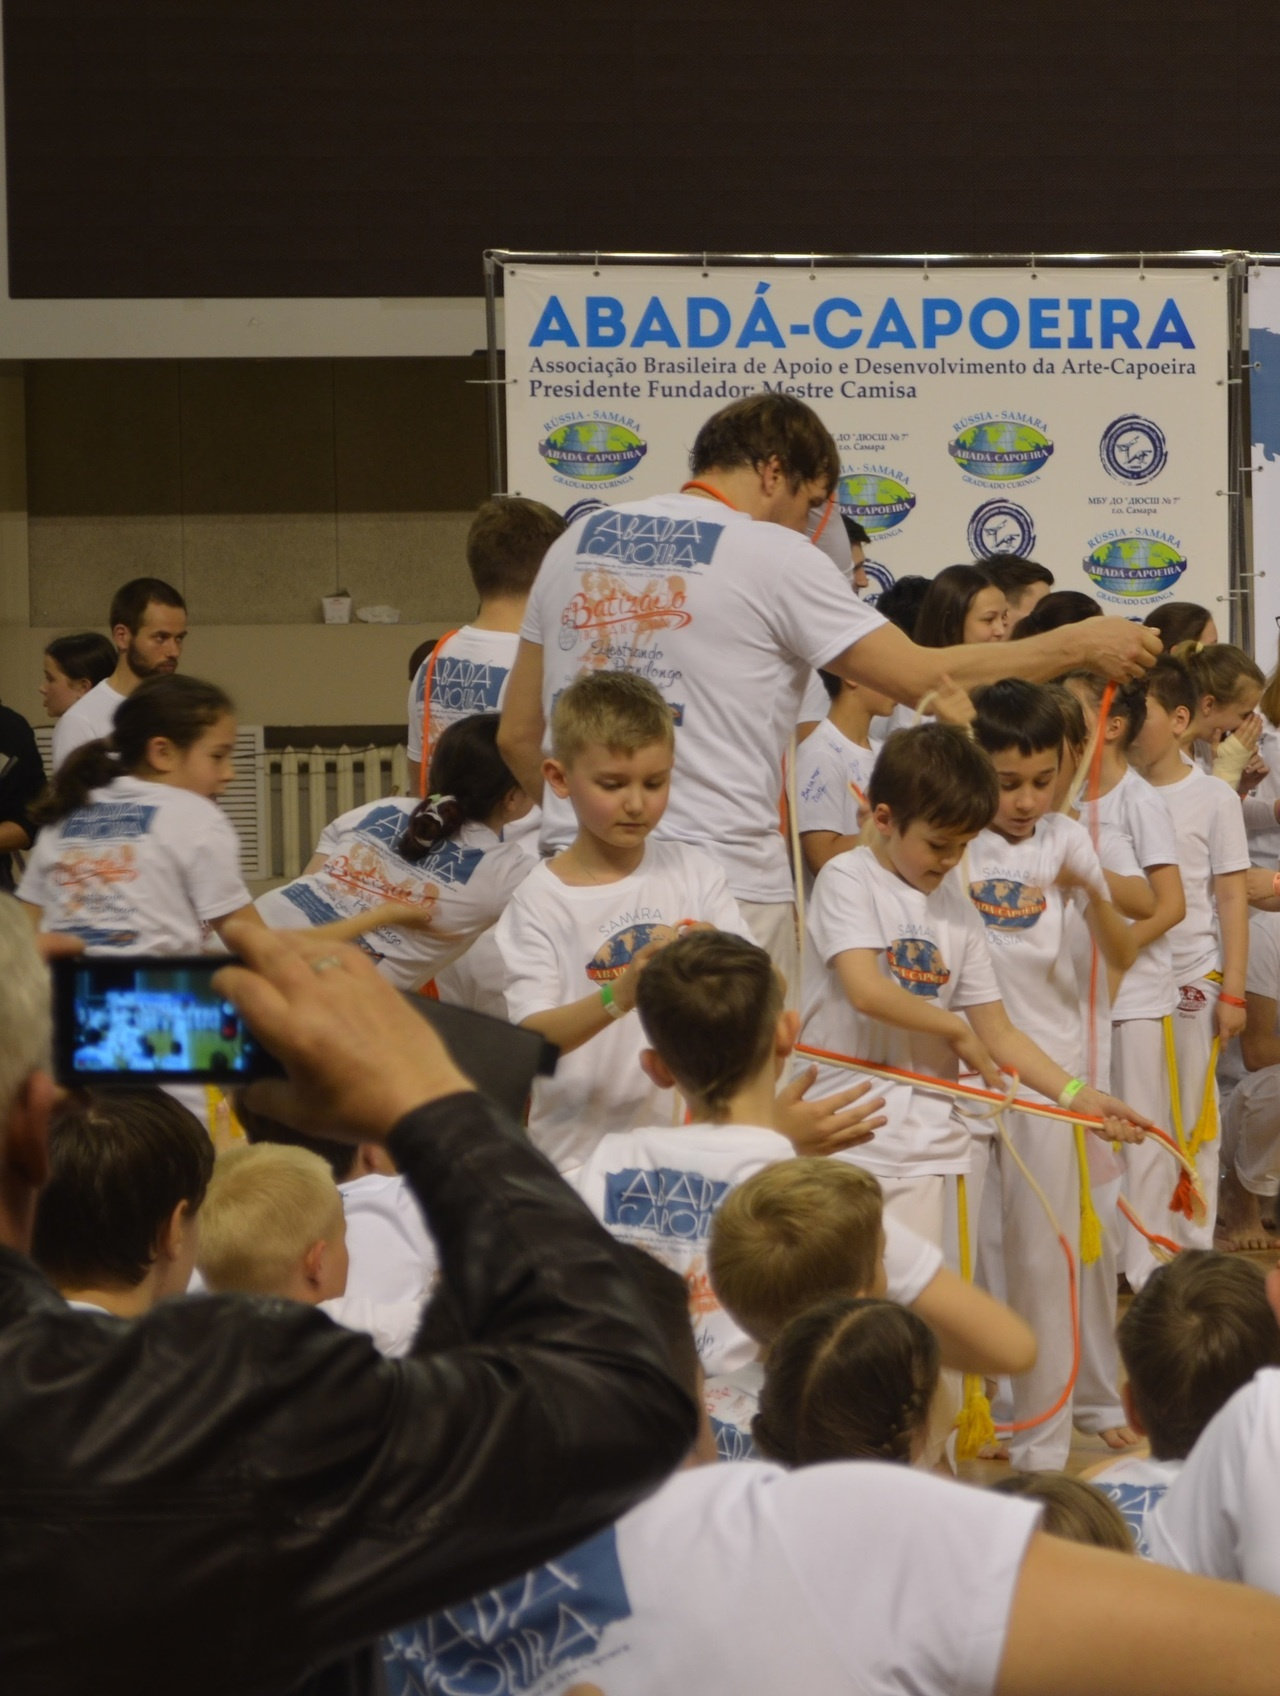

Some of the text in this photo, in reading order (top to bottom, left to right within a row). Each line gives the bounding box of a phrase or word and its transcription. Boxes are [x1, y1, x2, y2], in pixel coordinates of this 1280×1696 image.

[528, 281, 1196, 350] ABADÁ-CAPOEIRA
[529, 356, 1196, 379] Associação Brasileira de Apoio e Desenvolvimento da Arte-Capoeira
[529, 379, 917, 400] Presidente Fundador: Mestre Camisa
[593, 410, 641, 432] SAMARA
[1001, 411, 1048, 432] SAMARA
[853, 443, 885, 452] Самара
[545, 449, 641, 462] ABADÁ-CAPOEIRA
[954, 449, 1049, 462] ABADÁ-CAPOEIRA
[863, 463, 910, 485] SAMARA
[552, 475, 634, 490] GRADUADO CURINGA
[962, 475, 1041, 489] GRADUADO CURINGA
[840, 502, 911, 515] DÁ-CAPOEIRA
[1126, 506, 1157, 515] Самара
[1135, 527, 1182, 549] SAMARA
[585, 536, 697, 566] CAPOEIRA
[1089, 565, 1182, 578] ABADÁ-CAPOEIRA
[1096, 591, 1174, 605] GRADUADO CURINGA
